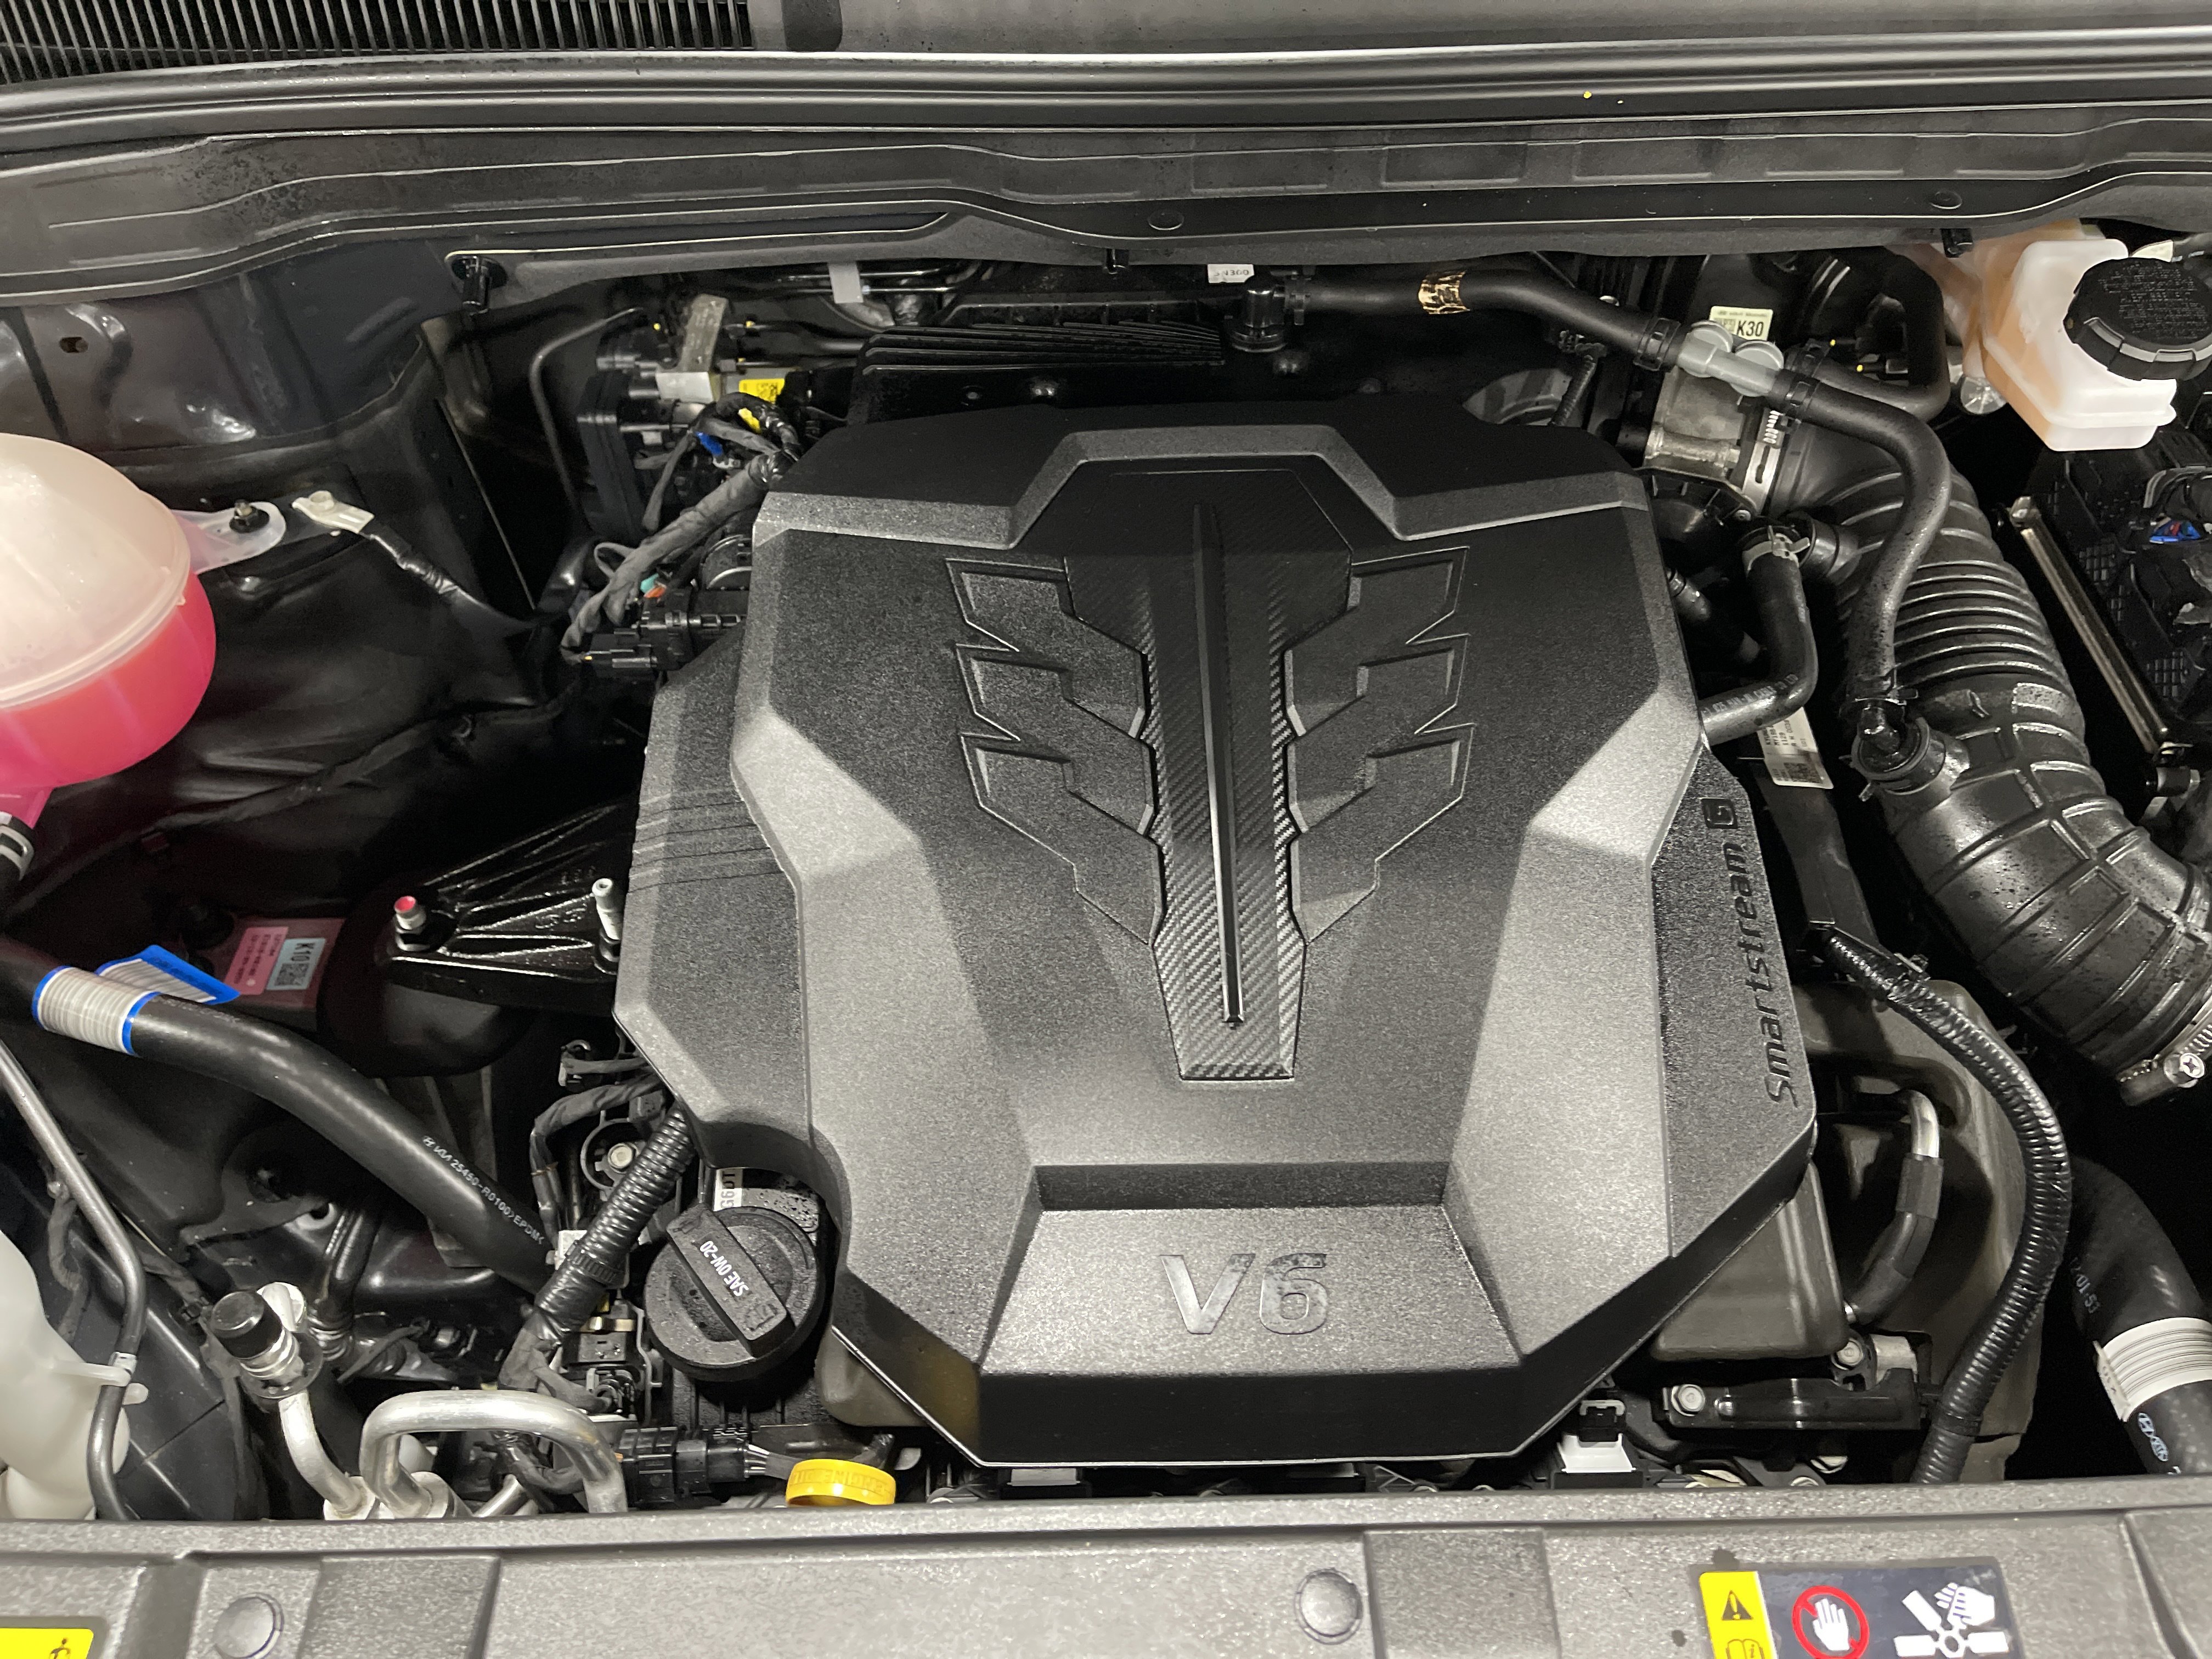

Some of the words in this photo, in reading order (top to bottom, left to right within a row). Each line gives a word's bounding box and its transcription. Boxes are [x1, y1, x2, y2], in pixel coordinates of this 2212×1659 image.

[1737, 320, 1764, 336] K30
[1779, 732, 1788, 745] 1129
[291, 943, 315, 962] K10
[1722, 842, 1799, 1108] Smartstream
[699, 1240, 732, 1276] 0W-20
[723, 1271, 749, 1297] SAE
[793, 1272, 810, 1311] OPEN
[1160, 1253, 1328, 1335] V6
[793, 1470, 815, 1484] OIL
[823, 1470, 884, 1493] ENGINE
